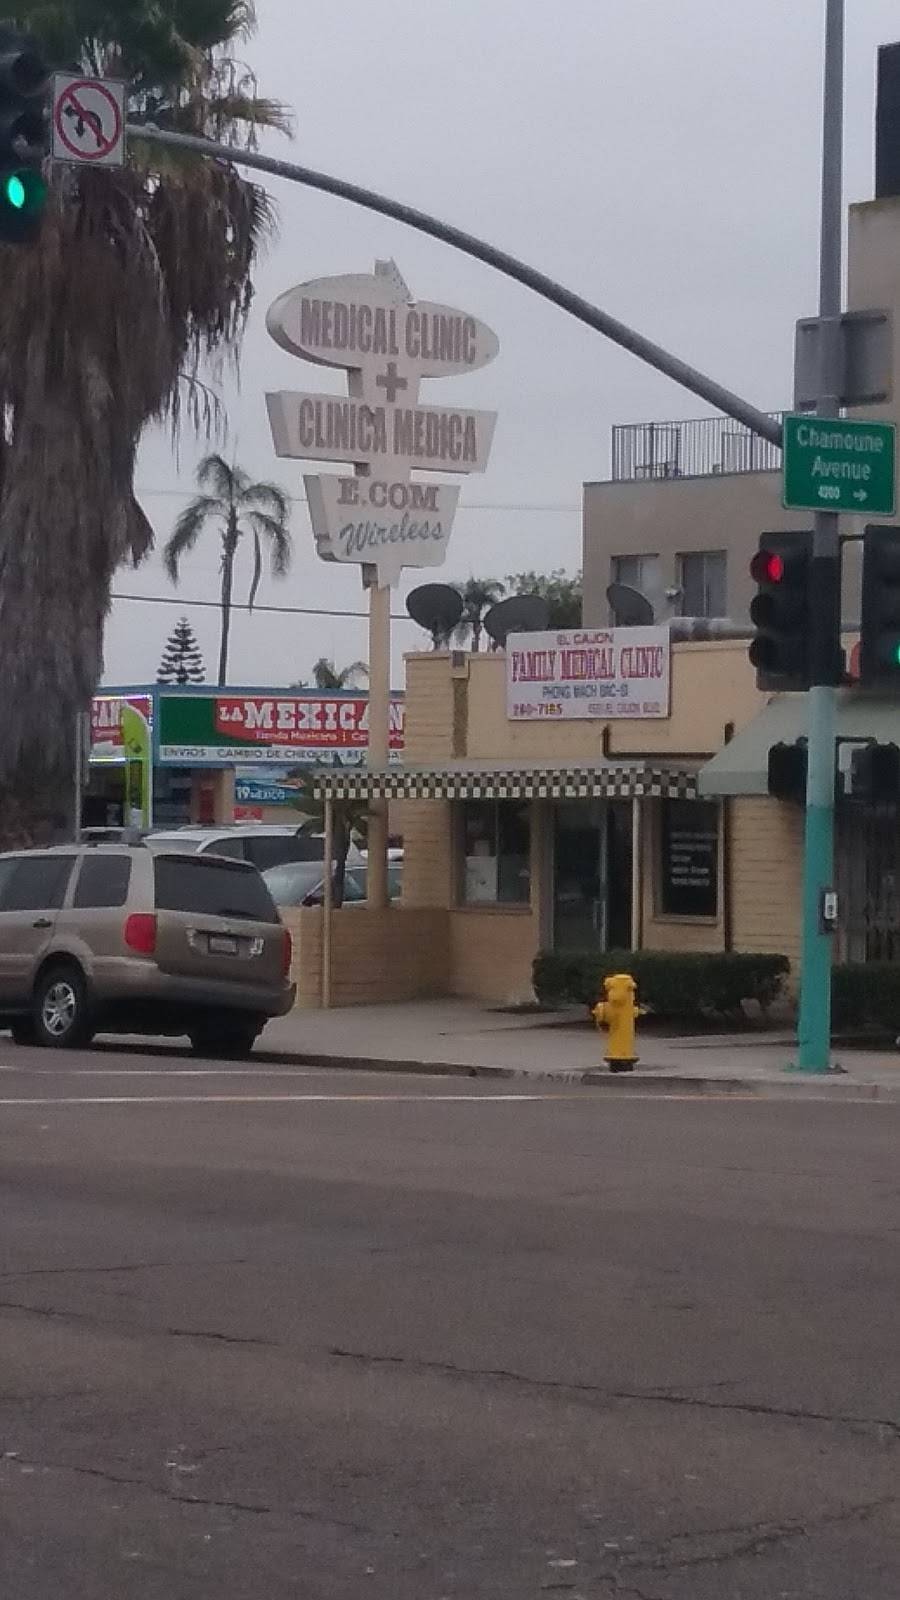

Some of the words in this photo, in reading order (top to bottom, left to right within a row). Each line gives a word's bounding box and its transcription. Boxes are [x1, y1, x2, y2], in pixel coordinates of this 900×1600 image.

[301, 297, 399, 356] MEDICAL
[405, 309, 476, 364] CLINIC
[299, 398, 386, 454] CLINICA
[393, 407, 477, 462] MEDICA
[797, 424, 884, 452] Chamoune
[811, 455, 871, 480] Avenue
[336, 477, 439, 512] E.COM
[339, 511, 445, 556] Wireless
[556, 634, 570, 645] EL
[573, 632, 614, 644] CAJON
[511, 650, 556, 682] FAMILY
[559, 648, 616, 680] MEDICAL
[620, 646, 663, 678] CLINIC
[219, 706, 243, 721] LA
[217, 749, 262, 759] CAMBIO
[266, 749, 280, 759] DE
